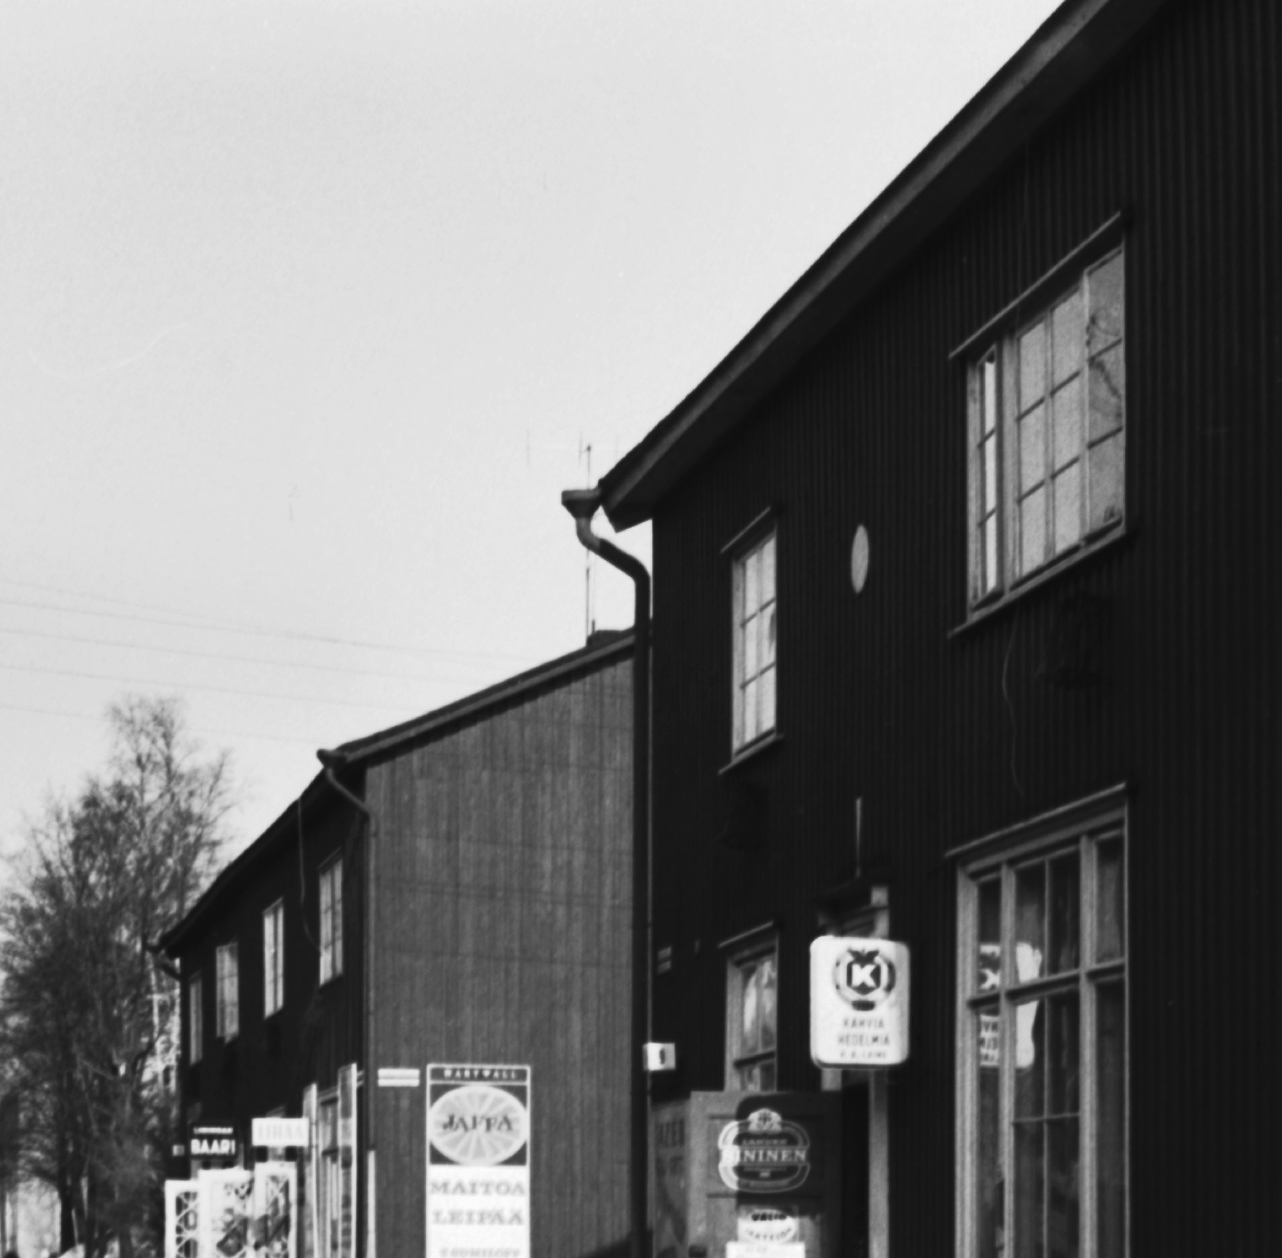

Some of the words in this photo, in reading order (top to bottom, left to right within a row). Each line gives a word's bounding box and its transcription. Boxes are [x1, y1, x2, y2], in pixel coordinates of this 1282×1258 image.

[852, 963, 877, 987] K
[843, 1018, 884, 1028] KAHVIA
[442, 1114, 513, 1132] JAFFA
[190, 1138, 236, 1155] BAARI
[429, 1180, 526, 1196] MAITOA
[432, 1207, 524, 1225] LEIPÄÄ
[751, 1211, 788, 1222] VALIO
